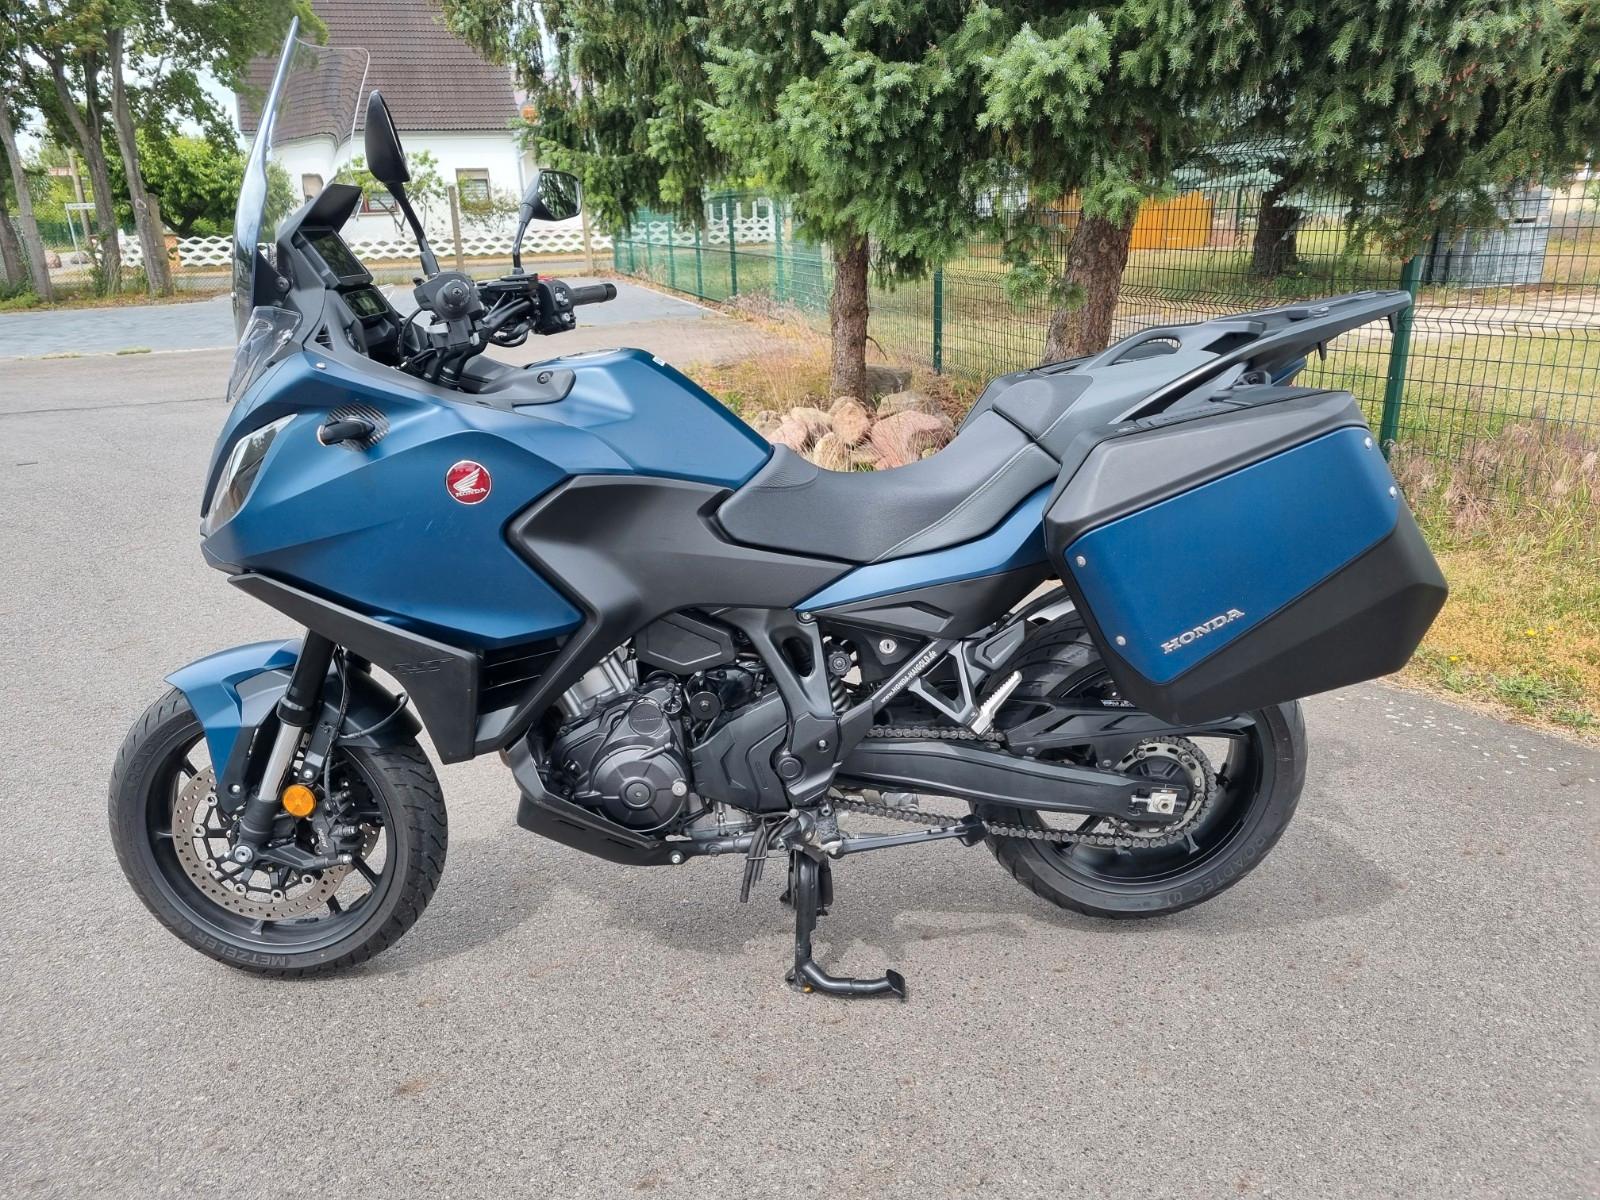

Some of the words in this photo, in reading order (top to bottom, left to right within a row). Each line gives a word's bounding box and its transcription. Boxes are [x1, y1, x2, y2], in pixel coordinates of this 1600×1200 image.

[454, 487, 488, 498] HONDA
[1160, 608, 1245, 655] HONDA
[194, 931, 287, 967] METZELER
